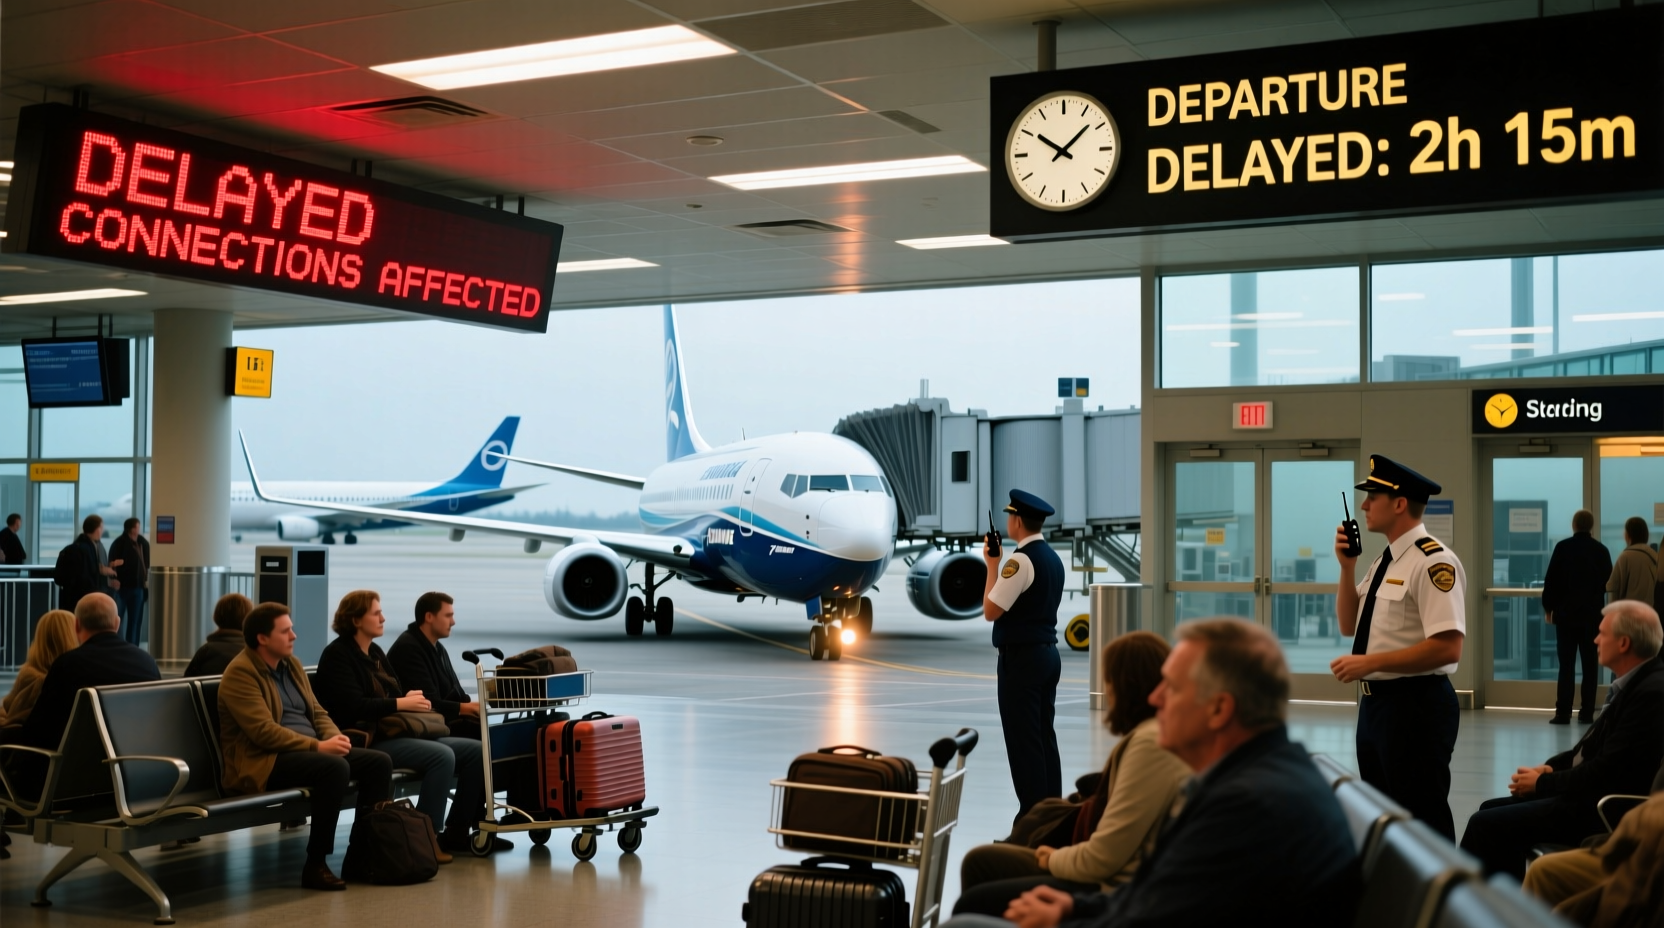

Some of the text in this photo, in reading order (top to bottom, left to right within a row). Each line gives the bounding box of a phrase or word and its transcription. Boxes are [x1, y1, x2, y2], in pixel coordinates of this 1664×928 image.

[1148, 62, 1408, 127] DEPARTURE
[75, 131, 375, 246] DELAYED
[1147, 107, 1637, 194] DELAYED: 2h 15m
[60, 201, 541, 318] CONNECTIONS AFFECTED
